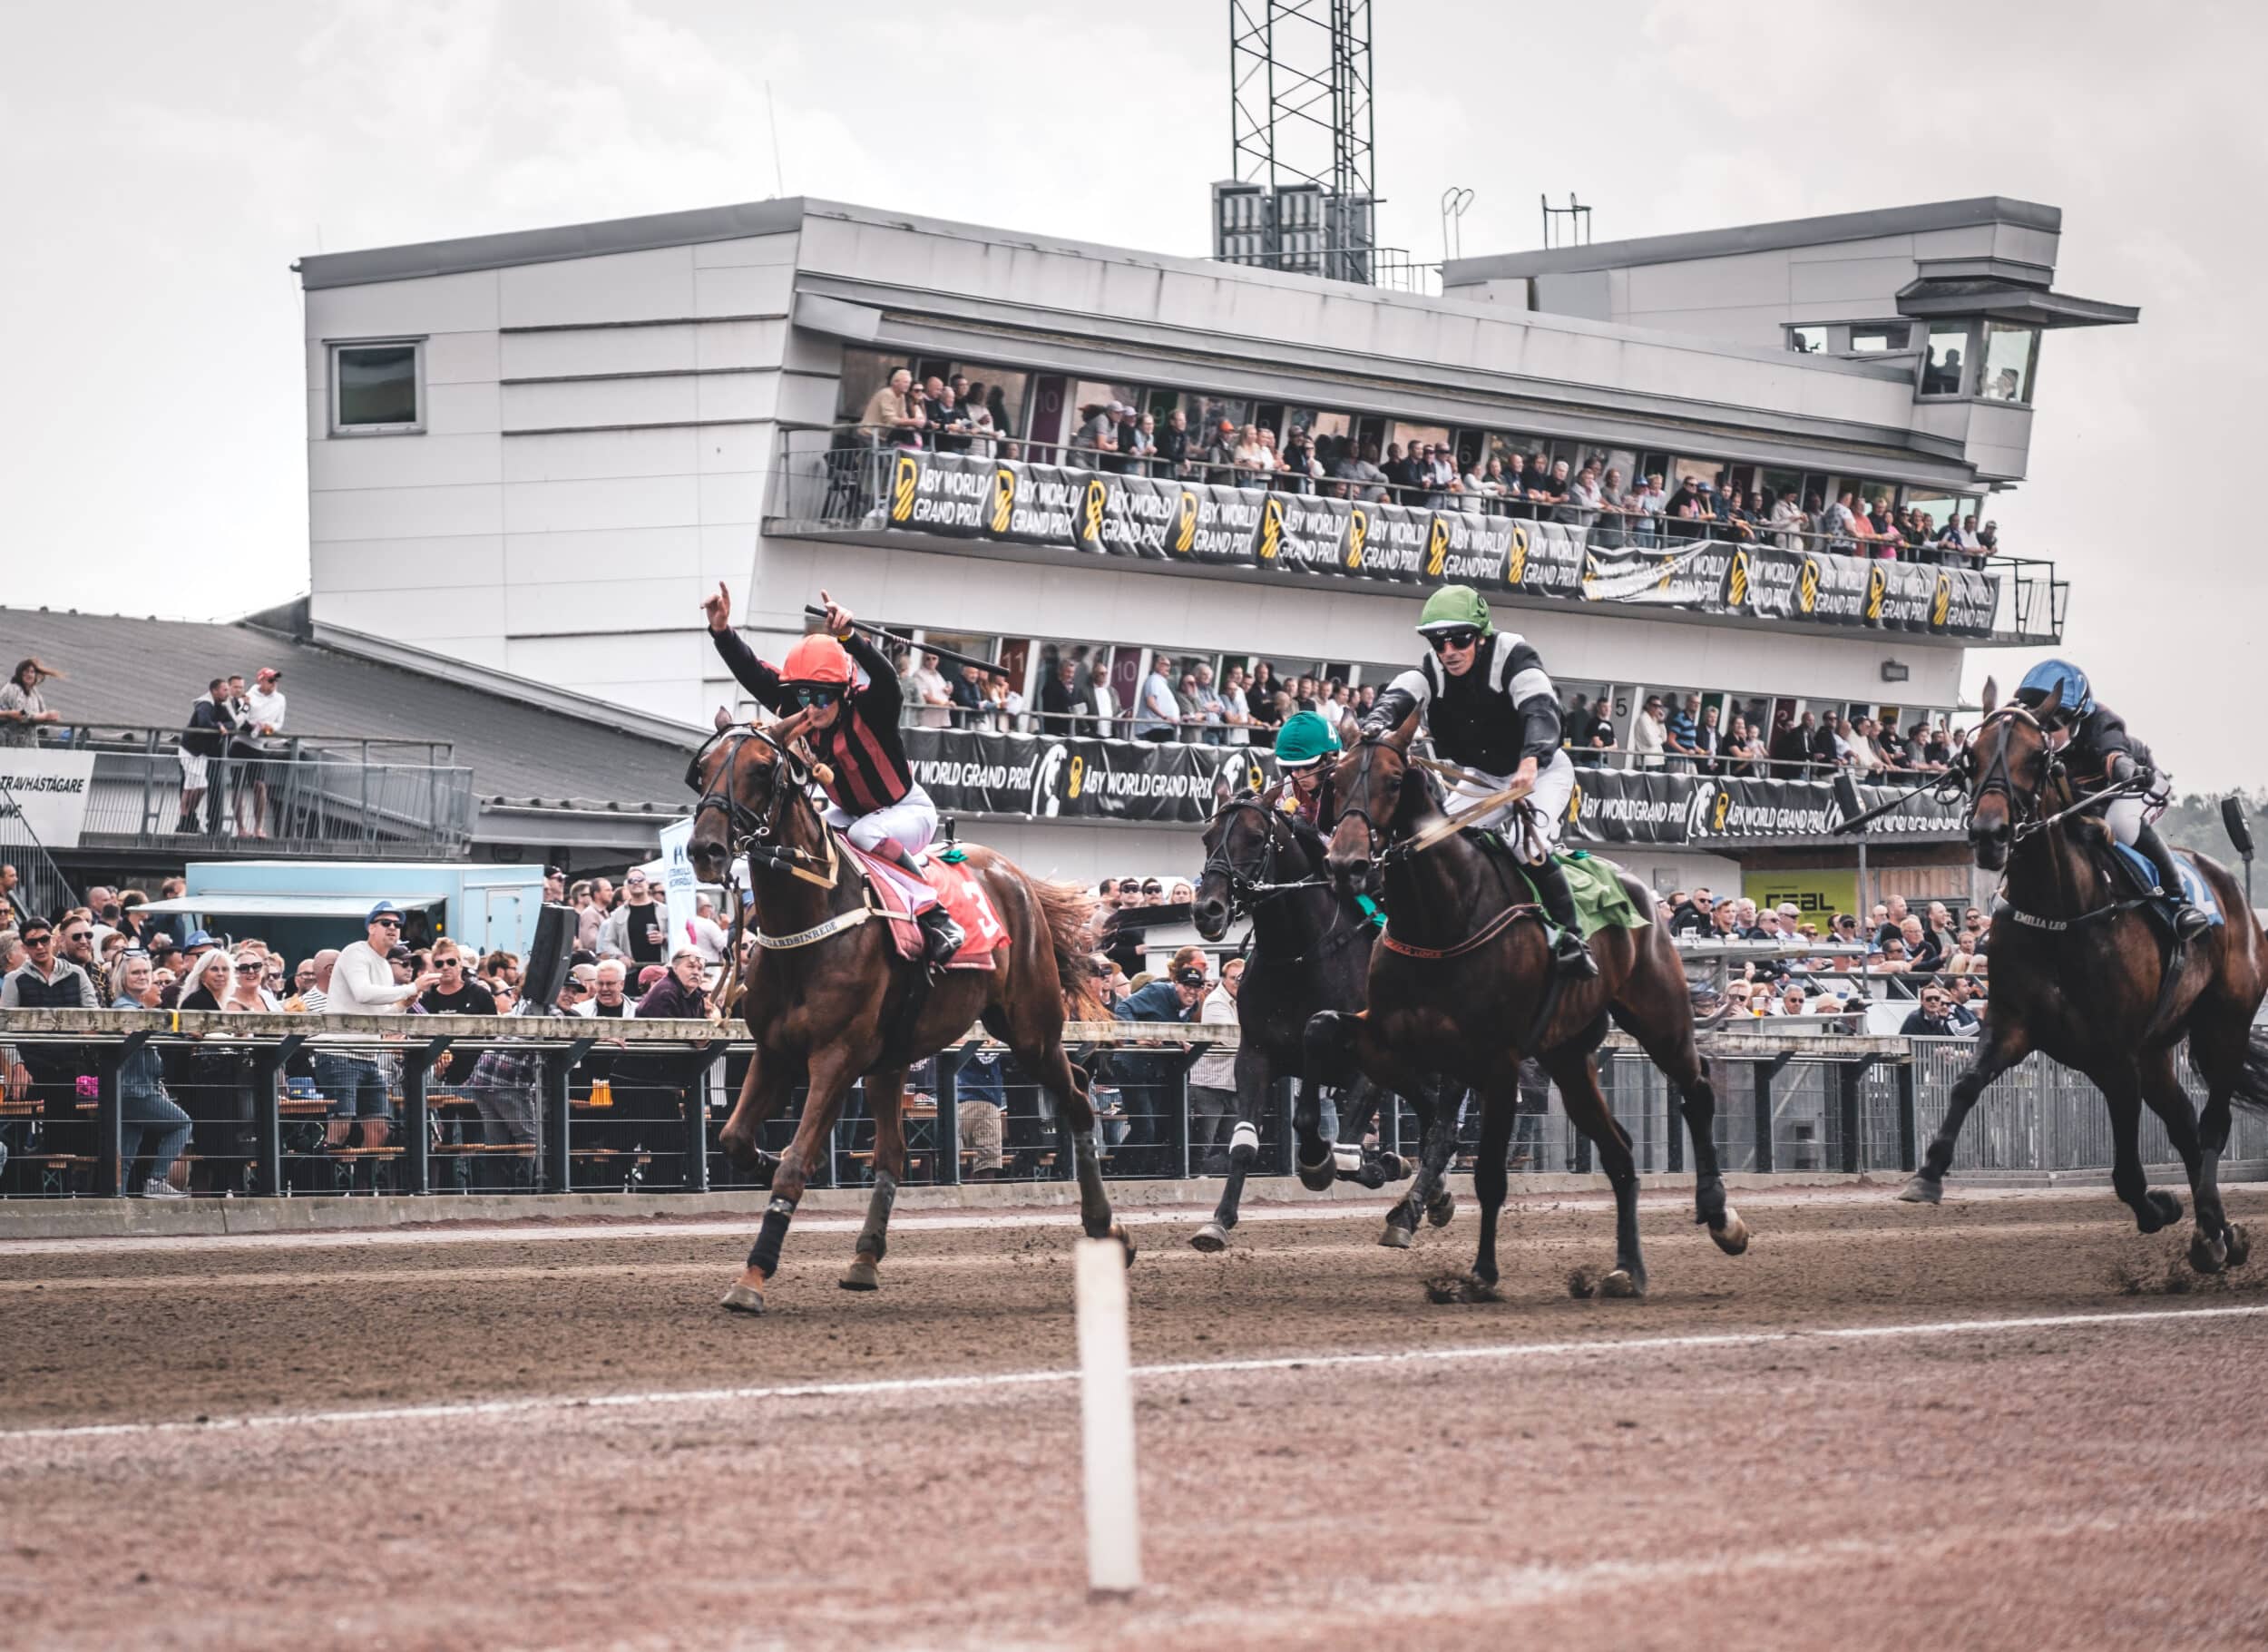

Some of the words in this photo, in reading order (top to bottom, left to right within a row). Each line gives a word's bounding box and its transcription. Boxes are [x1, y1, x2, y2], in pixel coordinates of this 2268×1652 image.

[918, 463, 944, 493] ÅBY
[944, 471, 986, 497] WORLD
[1039, 482, 1079, 508] WORLD
[1129, 493, 1171, 519] WORLD
[914, 498, 955, 524] GRAND
[956, 503, 982, 527] PRIX
[1012, 509, 1050, 534] GRAND
[1050, 513, 1071, 535] PRIX
[1198, 496, 1220, 523] ÅBY
[1221, 503, 1258, 526] WORLD
[1285, 504, 1306, 532] ÅBY
[1306, 513, 1344, 535] WORLD
[1193, 529, 1231, 553] GRAND
[1230, 533, 1252, 554] PRIX
[1367, 514, 1389, 542] ÅBY
[1390, 522, 1425, 545] WORLD
[1471, 531, 1505, 553] WORLD
[1316, 541, 1339, 563] PRIX
[1363, 546, 1400, 571] GRAND
[1399, 550, 1420, 572] PRIX
[1549, 539, 1581, 562] WORLD
[1444, 554, 1481, 578] GRAND
[1481, 558, 1501, 580] PRIX
[1524, 562, 1557, 586] GRAND
[1556, 566, 1578, 588] PRIX
[1693, 555, 1725, 576] WORLD
[1815, 593, 1846, 614] GRAND
[1881, 600, 1911, 620] GRAND
[1947, 607, 1976, 627] GRAND
[1002, 652, 1024, 674] 11
[1114, 661, 1137, 683] 10
[1616, 698, 1628, 718] 5
[1327, 722, 1338, 745] 4
[921, 761, 961, 786] WORLD
[962, 763, 1005, 788] GRAND
[1006, 767, 1031, 790] PRIX
[1082, 765, 1106, 794] ÅBY
[1107, 772, 1150, 797] WORLD
[1151, 774, 1188, 797] GRAND
[1188, 777, 1213, 799] PRIX
[1580, 792, 1600, 818] ÅBY
[1602, 799, 1633, 820] WORLD
[1634, 800, 1667, 822] GRAND
[1667, 802, 1686, 823] PRIX
[1745, 806, 1777, 827] WORLD
[1777, 808, 1807, 829] GRAND
[962, 881, 1000, 938] 3
[2013, 910, 2047, 929] EMILIA
[2048, 920, 2068, 931] LEO
